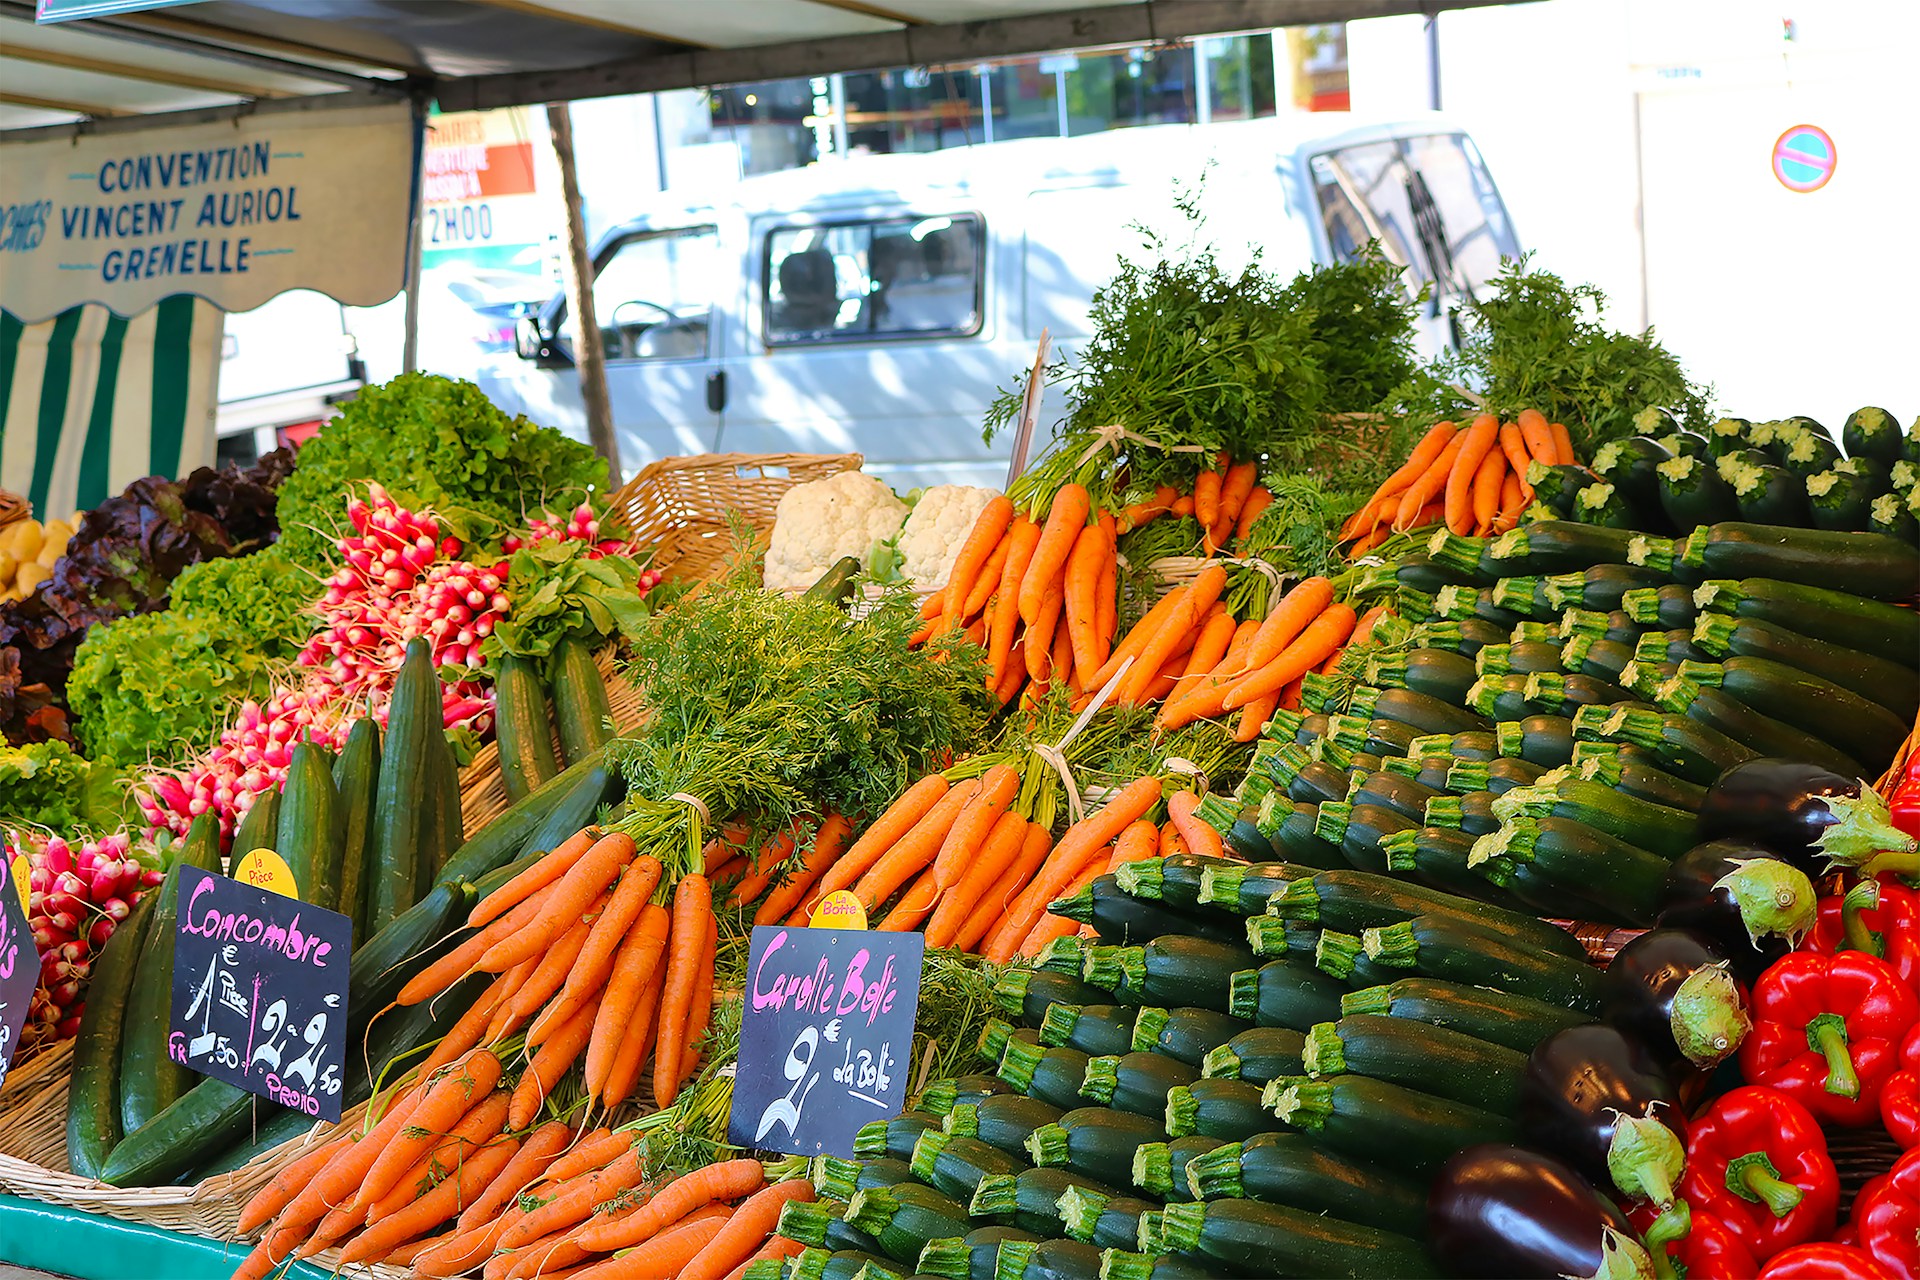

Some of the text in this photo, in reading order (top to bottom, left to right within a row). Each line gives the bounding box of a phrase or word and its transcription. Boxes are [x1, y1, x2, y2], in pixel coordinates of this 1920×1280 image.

[99, 141, 271, 194] CONVENTION
[61, 186, 301, 239] VINCENT AURIOL
[424, 204, 493, 243] 2H00
[102, 238, 250, 282] GRENELLE
[249, 870, 274, 886] Pièce
[823, 901, 857, 915] Botte
[835, 895, 847, 904] La
[182, 876, 333, 967] Concombre
[168, 1031, 188, 1065] FR
